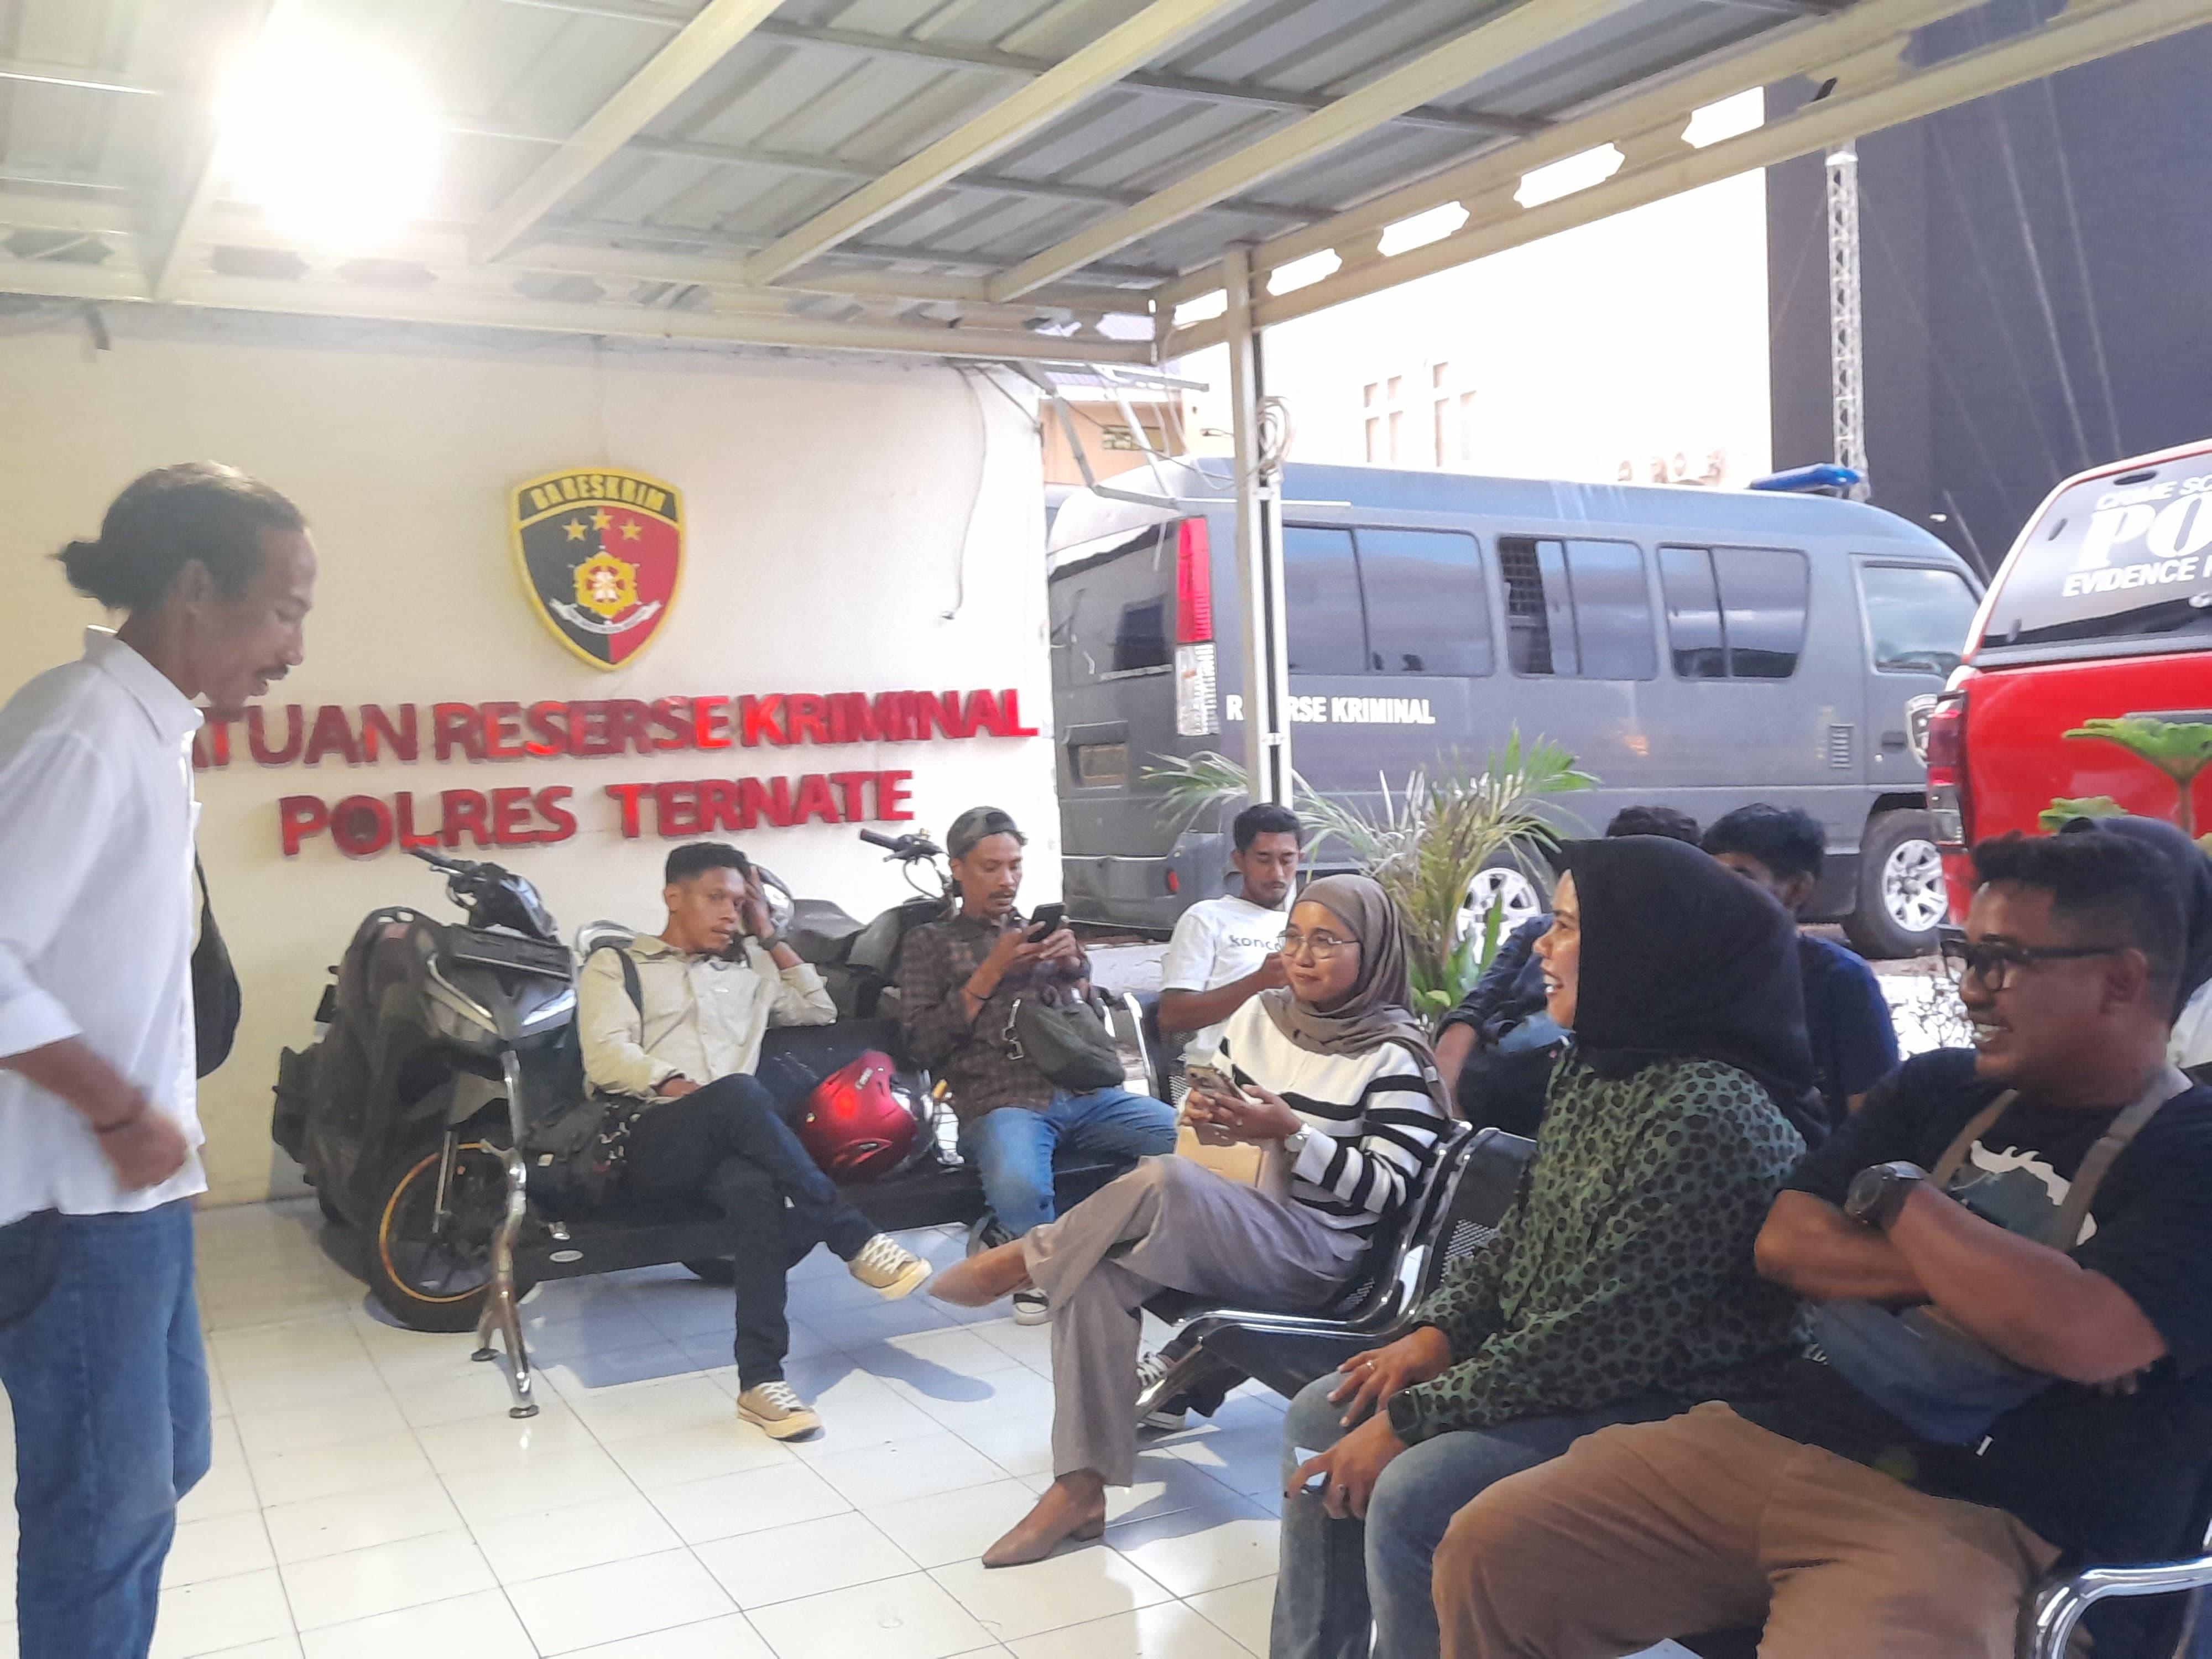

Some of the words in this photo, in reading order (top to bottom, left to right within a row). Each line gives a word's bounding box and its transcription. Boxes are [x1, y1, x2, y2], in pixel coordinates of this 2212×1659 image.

[2062, 556, 2199, 597] EVIDENCE
[192, 703, 419, 768] TUAN
[433, 695, 733, 763] RESERSE
[738, 688, 1040, 748] KRIMINAL
[1332, 697, 1436, 724] KRIMINAL
[278, 786, 577, 857] POLRES
[608, 769, 915, 838] TERNATE
